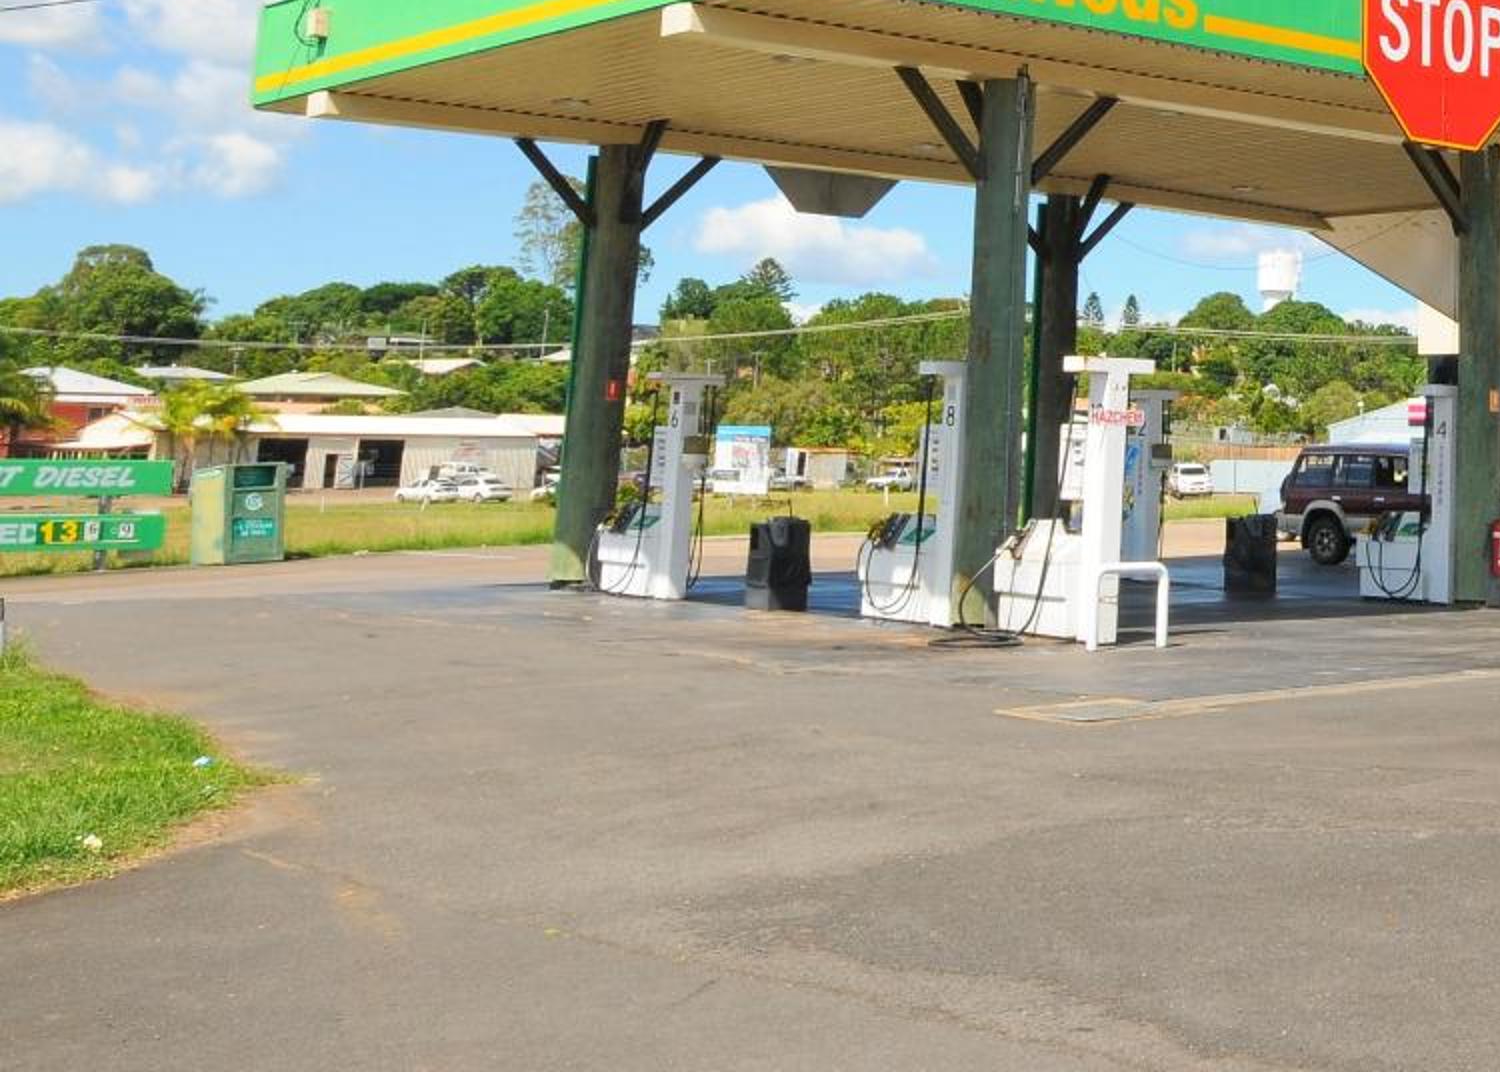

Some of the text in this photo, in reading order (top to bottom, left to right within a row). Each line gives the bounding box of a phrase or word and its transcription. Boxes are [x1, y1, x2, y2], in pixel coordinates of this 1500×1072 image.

[672, 409, 679, 428] 6
[946, 405, 955, 426] 8
[1090, 409, 1144, 424] HAZCHEM
[1436, 421, 1447, 440] 4
[33, 465, 137, 489] DIESEL
